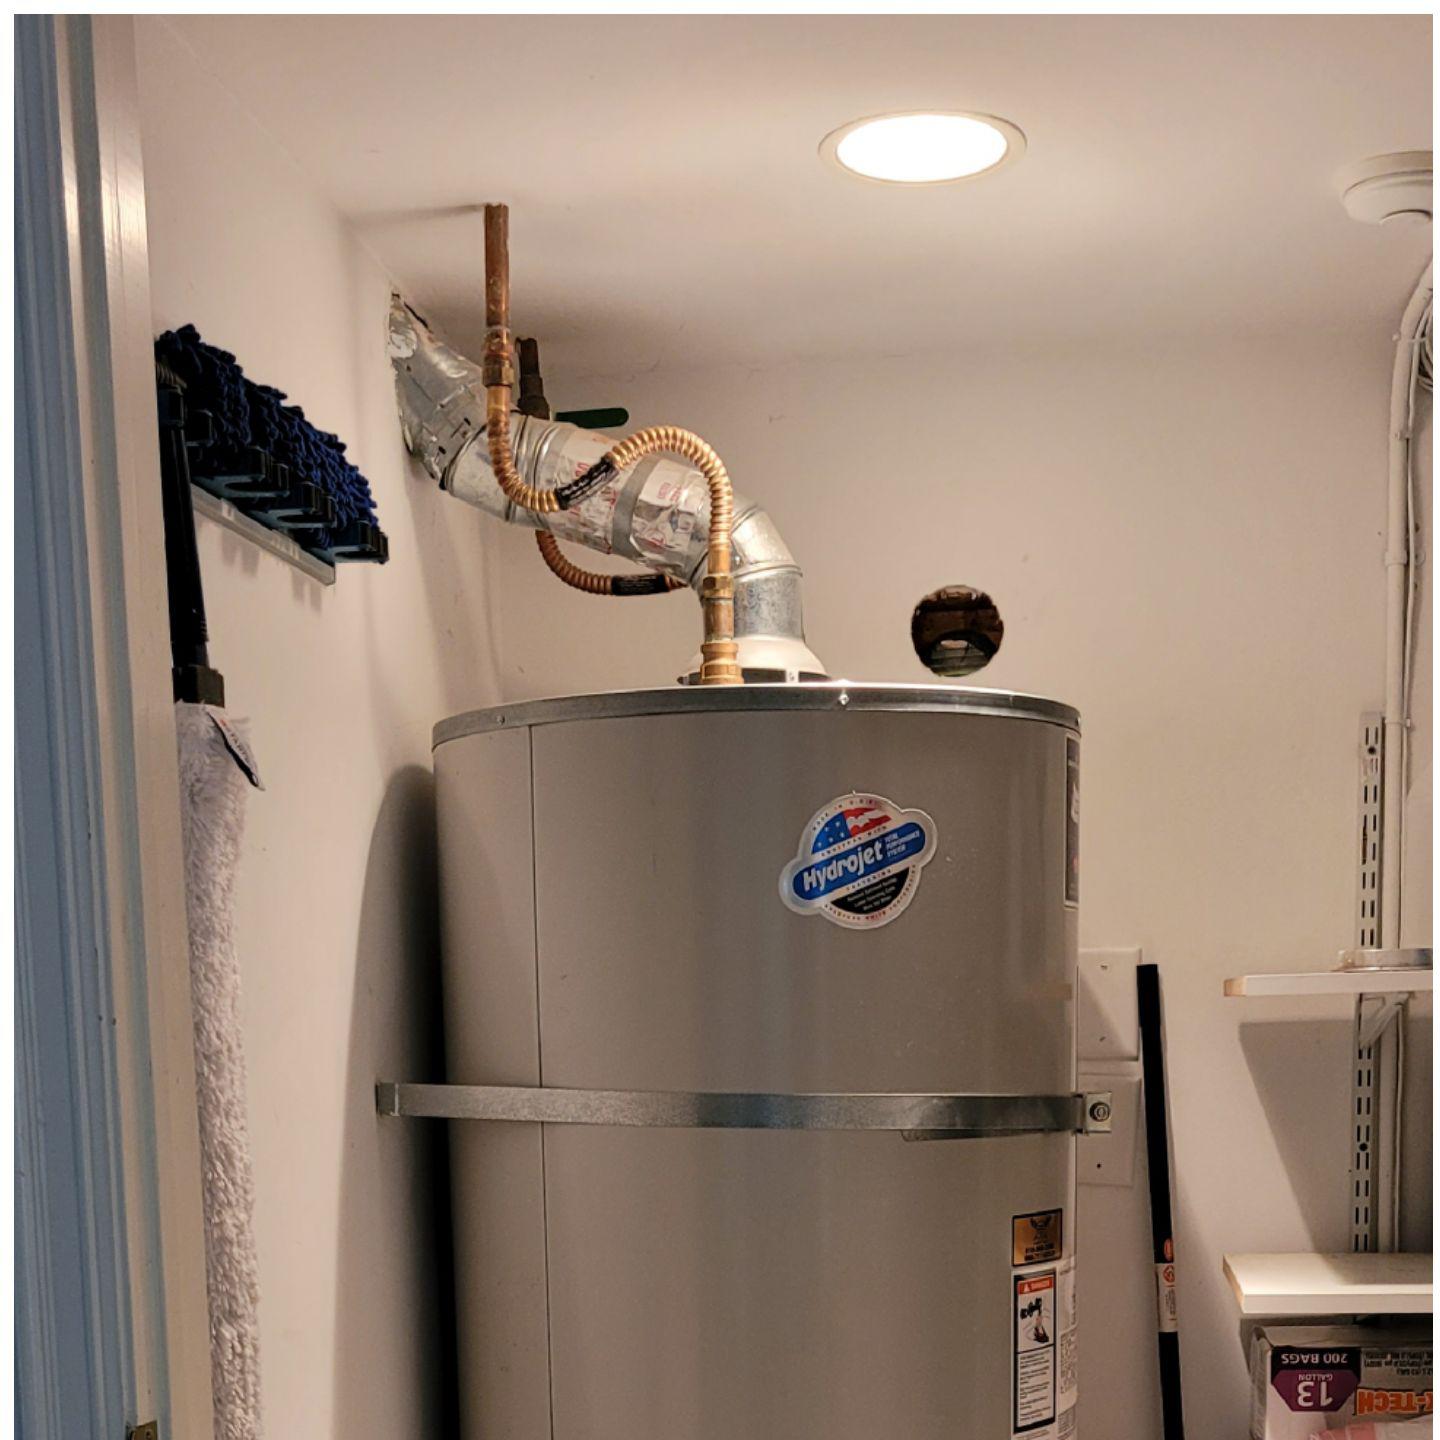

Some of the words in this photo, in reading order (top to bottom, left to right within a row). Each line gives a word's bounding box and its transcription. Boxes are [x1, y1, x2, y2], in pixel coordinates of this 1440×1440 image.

[803, 840, 883, 892] Hydrojet
[1281, 1353, 1320, 1364] BAGS
[1323, 1353, 1347, 1364] 200
[1298, 1373, 1333, 1381] GALLON
[1297, 1381, 1333, 1407] 13
